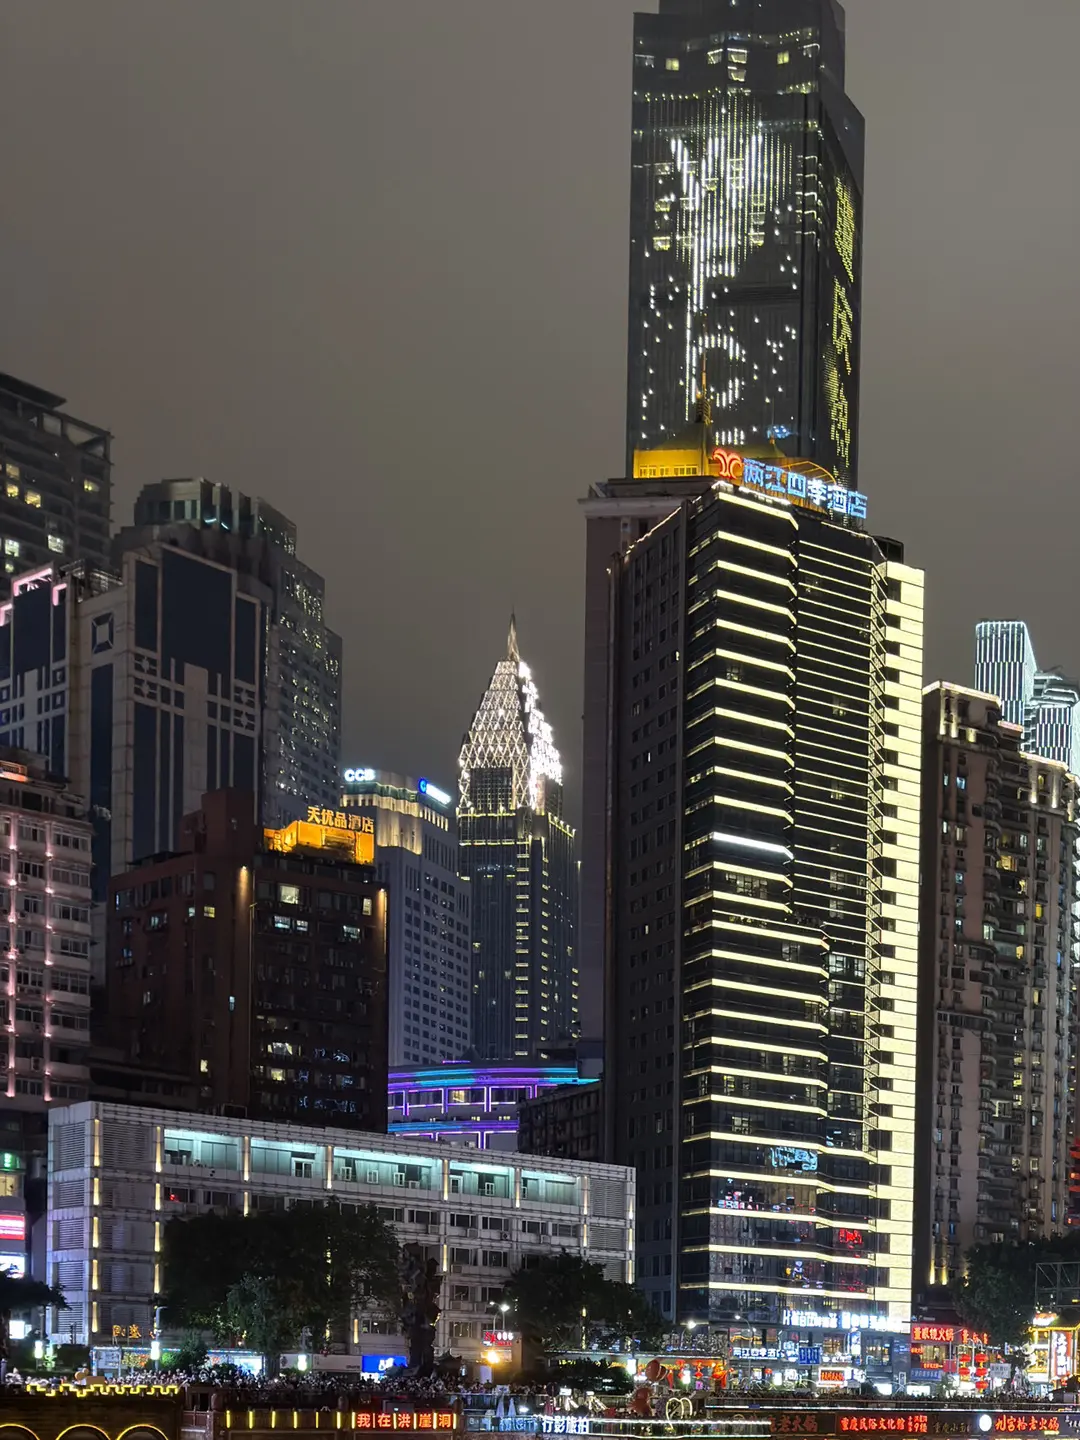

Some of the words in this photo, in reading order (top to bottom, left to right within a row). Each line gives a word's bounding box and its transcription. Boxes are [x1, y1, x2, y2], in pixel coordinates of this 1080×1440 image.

[344, 769, 376, 782] CCB
[356, 1412, 453, 1429] 我在洪崖洞
